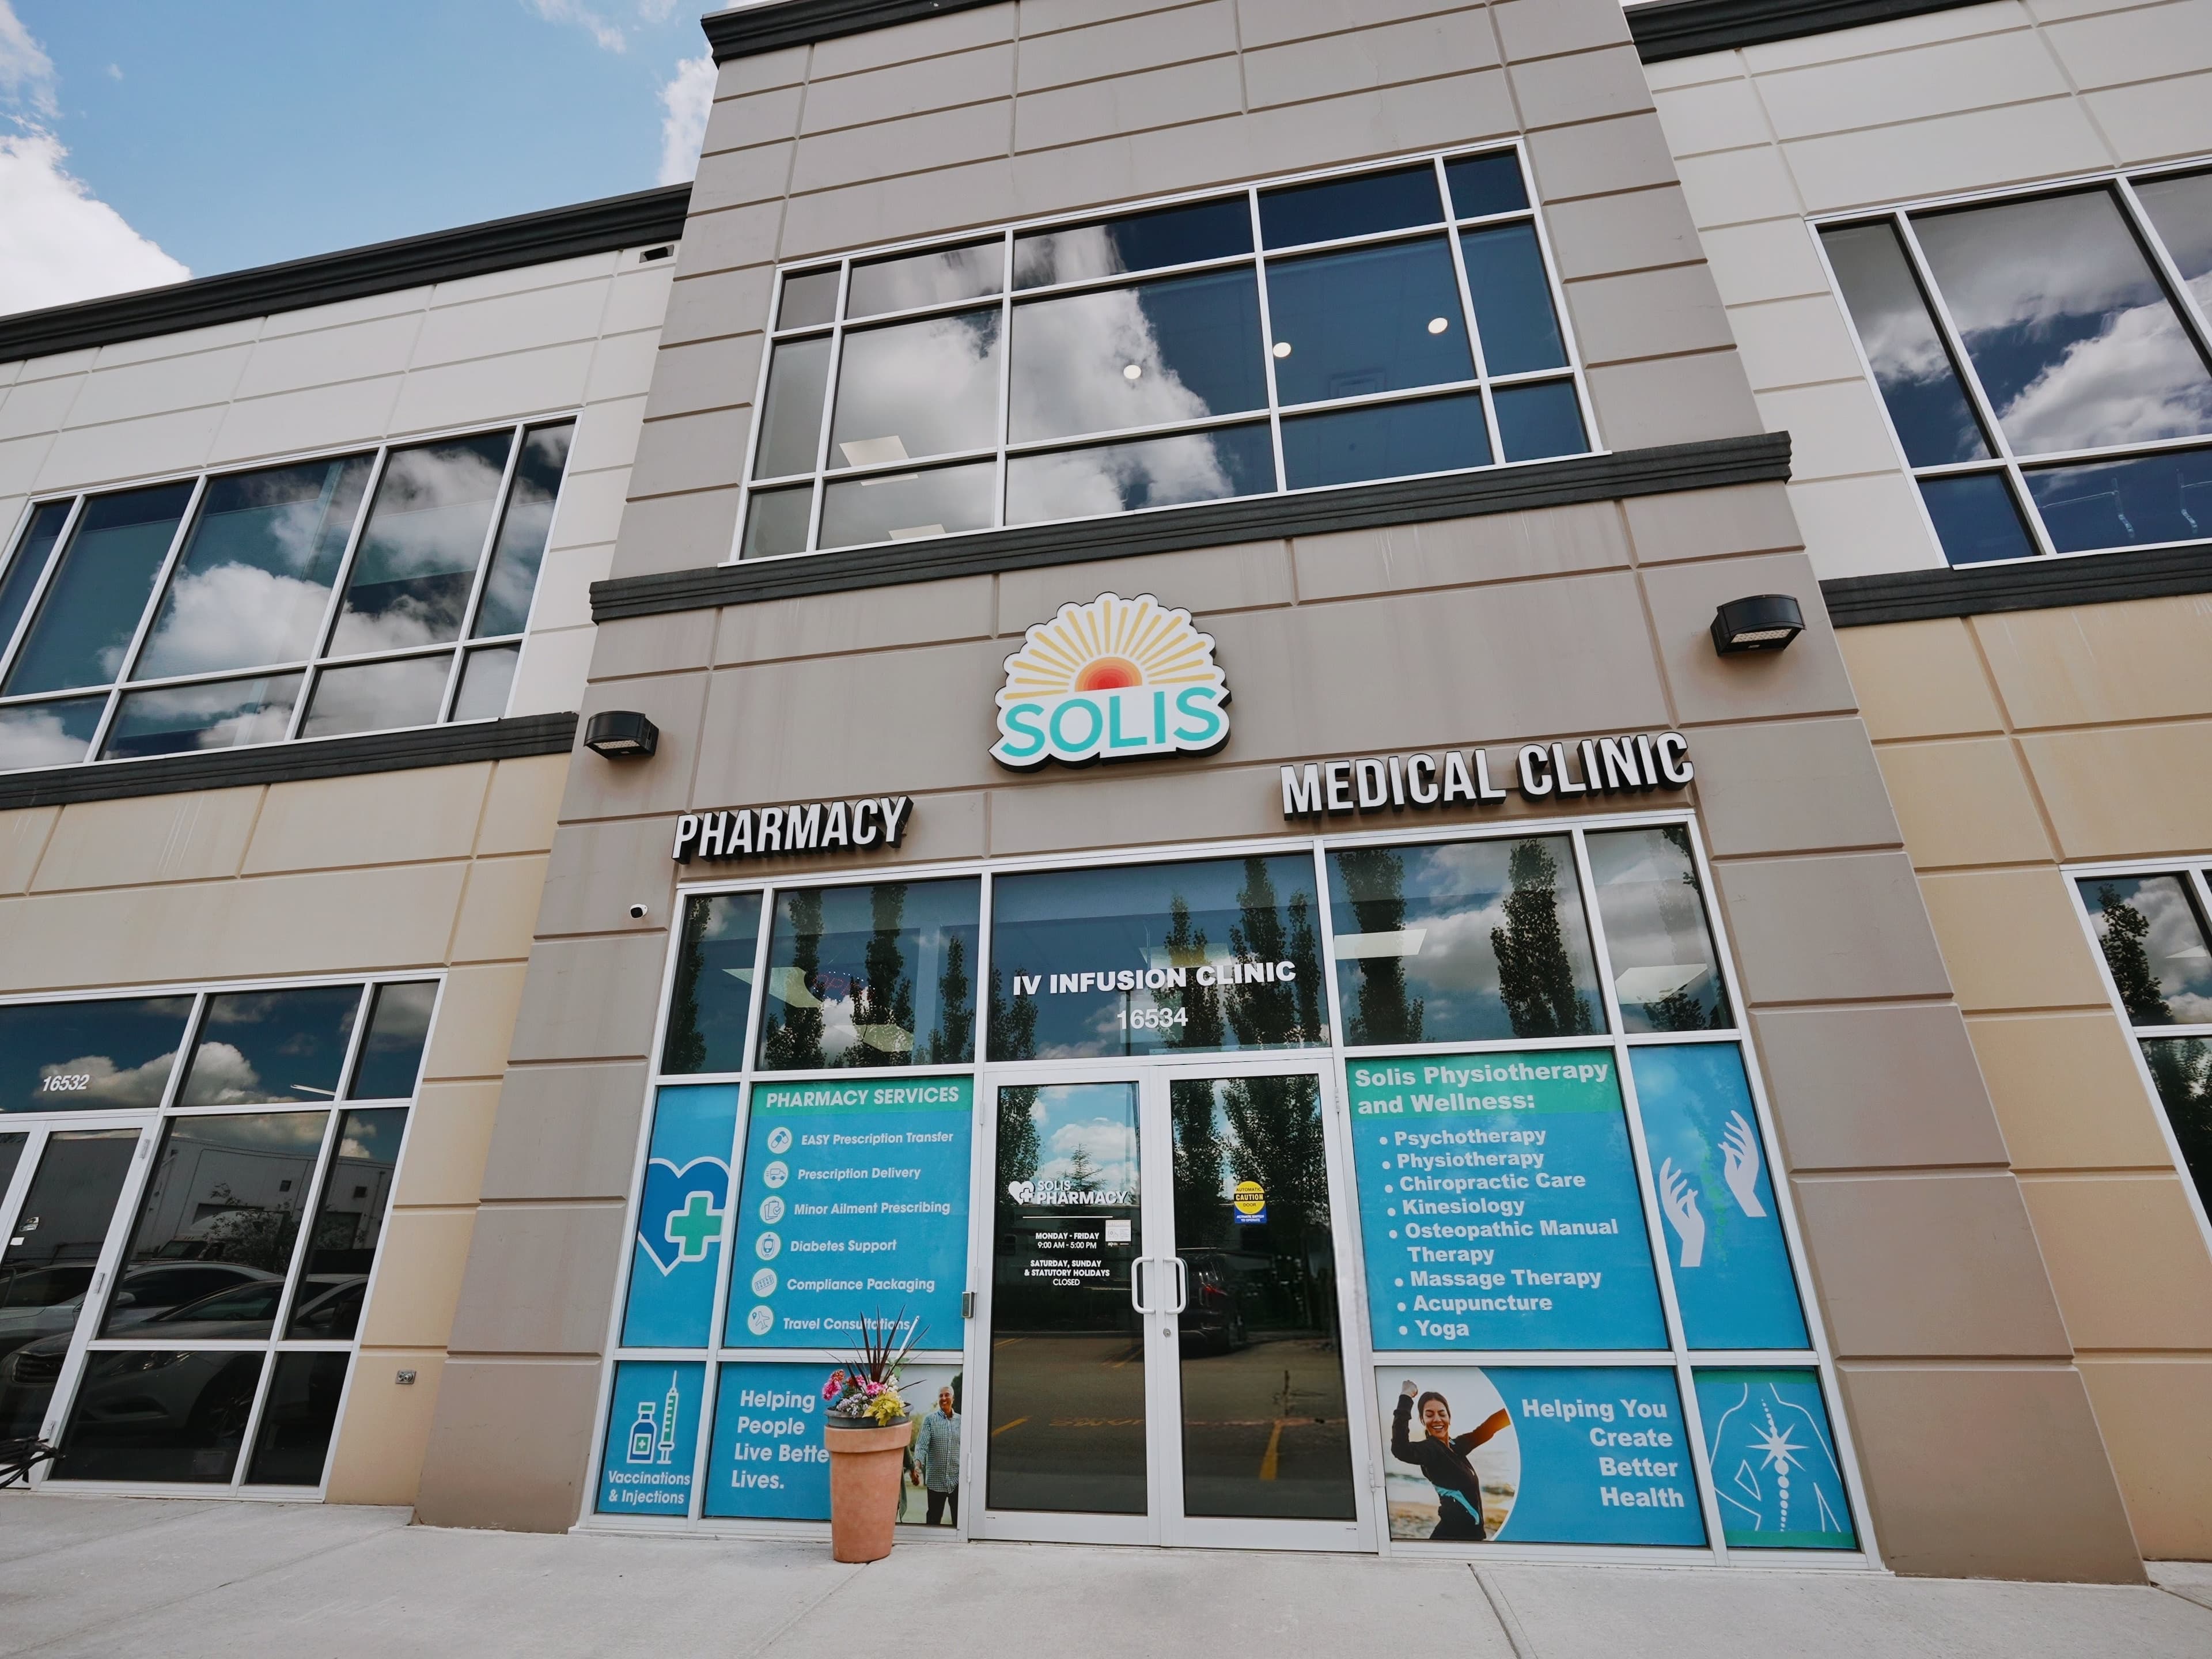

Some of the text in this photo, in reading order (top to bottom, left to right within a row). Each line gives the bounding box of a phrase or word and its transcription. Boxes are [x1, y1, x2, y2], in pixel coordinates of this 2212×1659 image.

[1001, 687, 1220, 757] SOLIS
[1280, 732, 1695, 819] MEDICAL CLINIC
[672, 796, 913, 862] PHARMACY
[1013, 961, 1296, 995] IV INFUSION CLINIC
[1117, 1007, 1188, 1030] 16534
[43, 1074, 90, 1092] 16532
[1355, 1063, 1608, 1088] Solis Physiotherapy
[766, 1086, 960, 1108] PHARMACY SERVICES
[1358, 1093, 1535, 1115] and Wellness:
[801, 1131, 954, 1146] EASY Prescription Transfer
[1394, 1129, 1546, 1149] Psychotherapy
[1397, 1153, 1544, 1171] Physiotherapy
[798, 1167, 921, 1181] Prescription Delivery
[1400, 1172, 1586, 1194] Chiropractic Care
[1038, 1180, 1071, 1192] SOLIS
[793, 1202, 951, 1215] Minor Ailment Prescribing
[1038, 1191, 1128, 1205] PHARMACY
[1402, 1198, 1525, 1217] Kinesiology
[1405, 1219, 1619, 1241] Osteopathic Manual
[790, 1238, 897, 1253] Diabetes Support
[1407, 1246, 1494, 1266] Therapy
[1030, 1260, 1070, 1268] SATURDAY,
[787, 1278, 935, 1293] Compliance Packaging
[1411, 1269, 1601, 1290] Massage Therapy
[1414, 1294, 1553, 1315] Acupuncture
[783, 1316, 820, 1330] Travel
[1415, 1319, 1469, 1340] Yoga
[740, 1389, 816, 1413] Helping
[1522, 1399, 1668, 1422] Helping You
[737, 1416, 805, 1438] People
[1589, 1427, 1673, 1448] Create
[734, 1442, 830, 1463] Live Bette
[608, 1469, 691, 1485] Vaccinations
[1599, 1457, 1679, 1477] Better
[731, 1469, 785, 1489] Lives.
[609, 1489, 684, 1506] & Injections
[1600, 1486, 1685, 1508] Health
